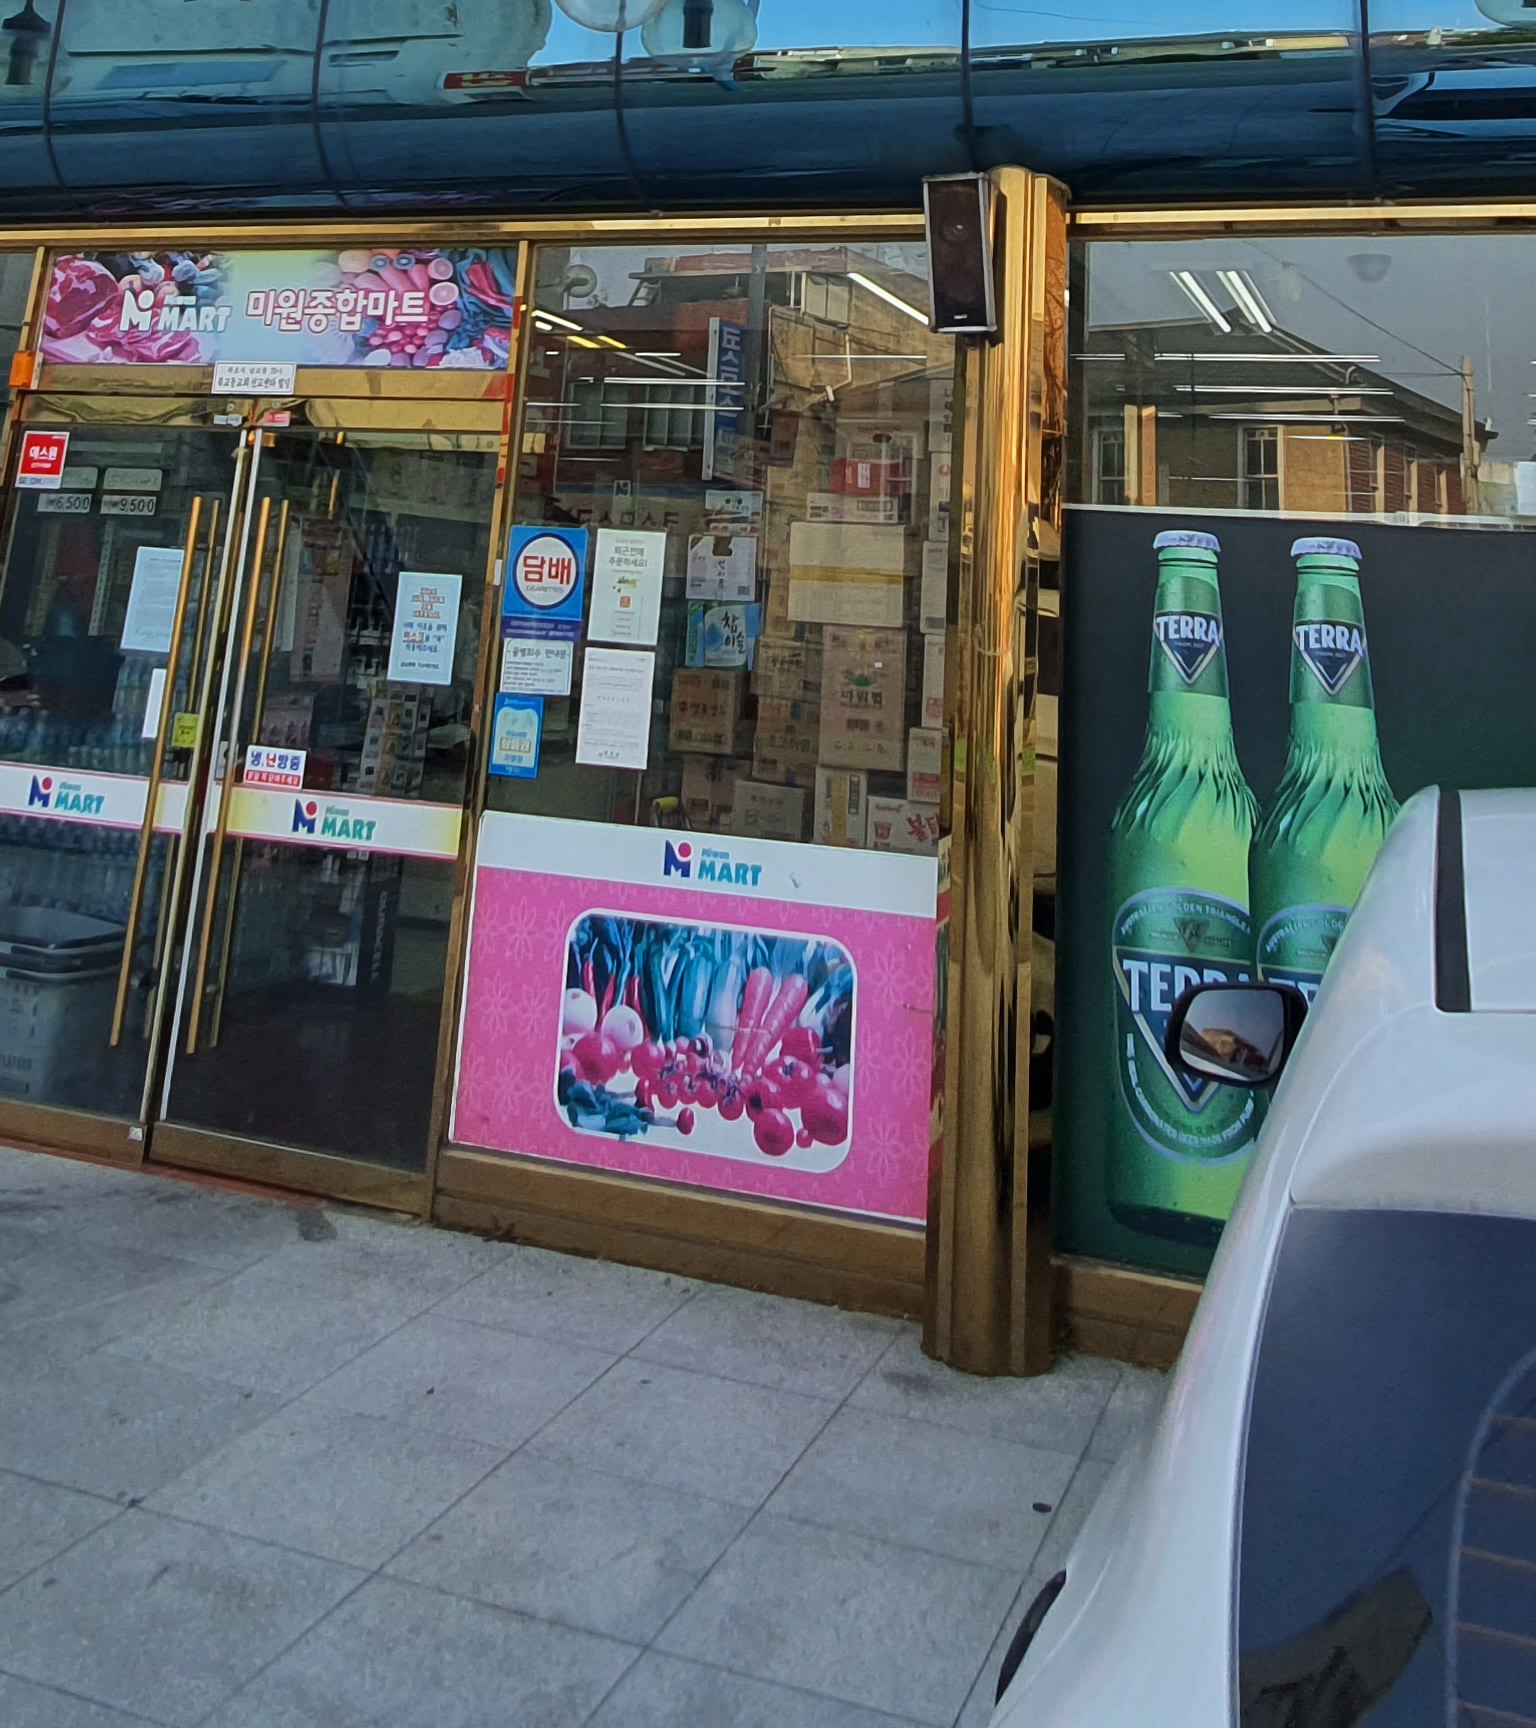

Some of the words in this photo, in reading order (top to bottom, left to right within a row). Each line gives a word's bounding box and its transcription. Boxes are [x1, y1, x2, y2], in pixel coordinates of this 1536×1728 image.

[156, 305, 231, 333] MART
[245, 287, 429, 333] 미원종합마트
[522, 554, 573, 586] 담배
[1155, 614, 1221, 647] TERRA
[1295, 623, 1364, 657] TERRA
[54, 792, 106, 815] MART
[320, 815, 377, 842] MART
[697, 858, 763, 887] MART
